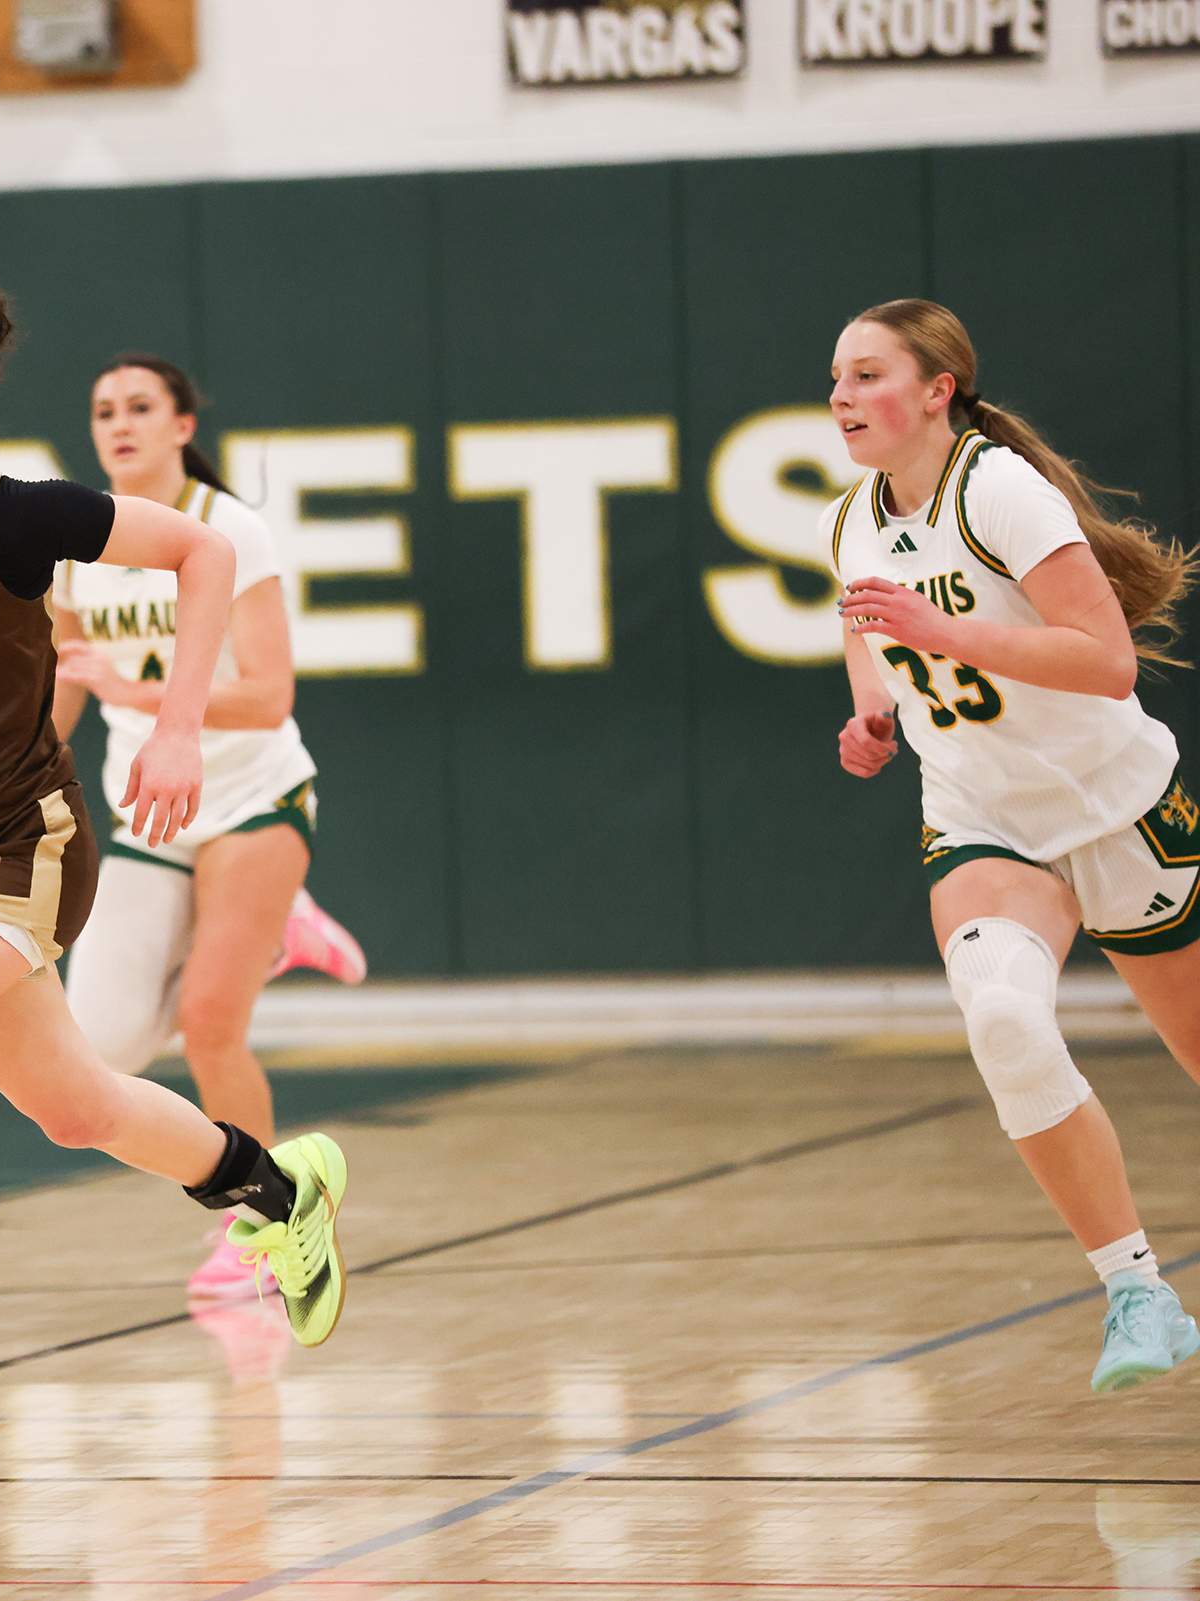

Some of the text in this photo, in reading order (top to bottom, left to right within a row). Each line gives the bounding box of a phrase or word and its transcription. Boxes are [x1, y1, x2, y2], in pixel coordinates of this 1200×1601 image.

[508, 3, 741, 82] VARGAS
[1106, 0, 1200, 47] CHO
[77, 598, 177, 642] MMAU
[880, 642, 1005, 731] 33
